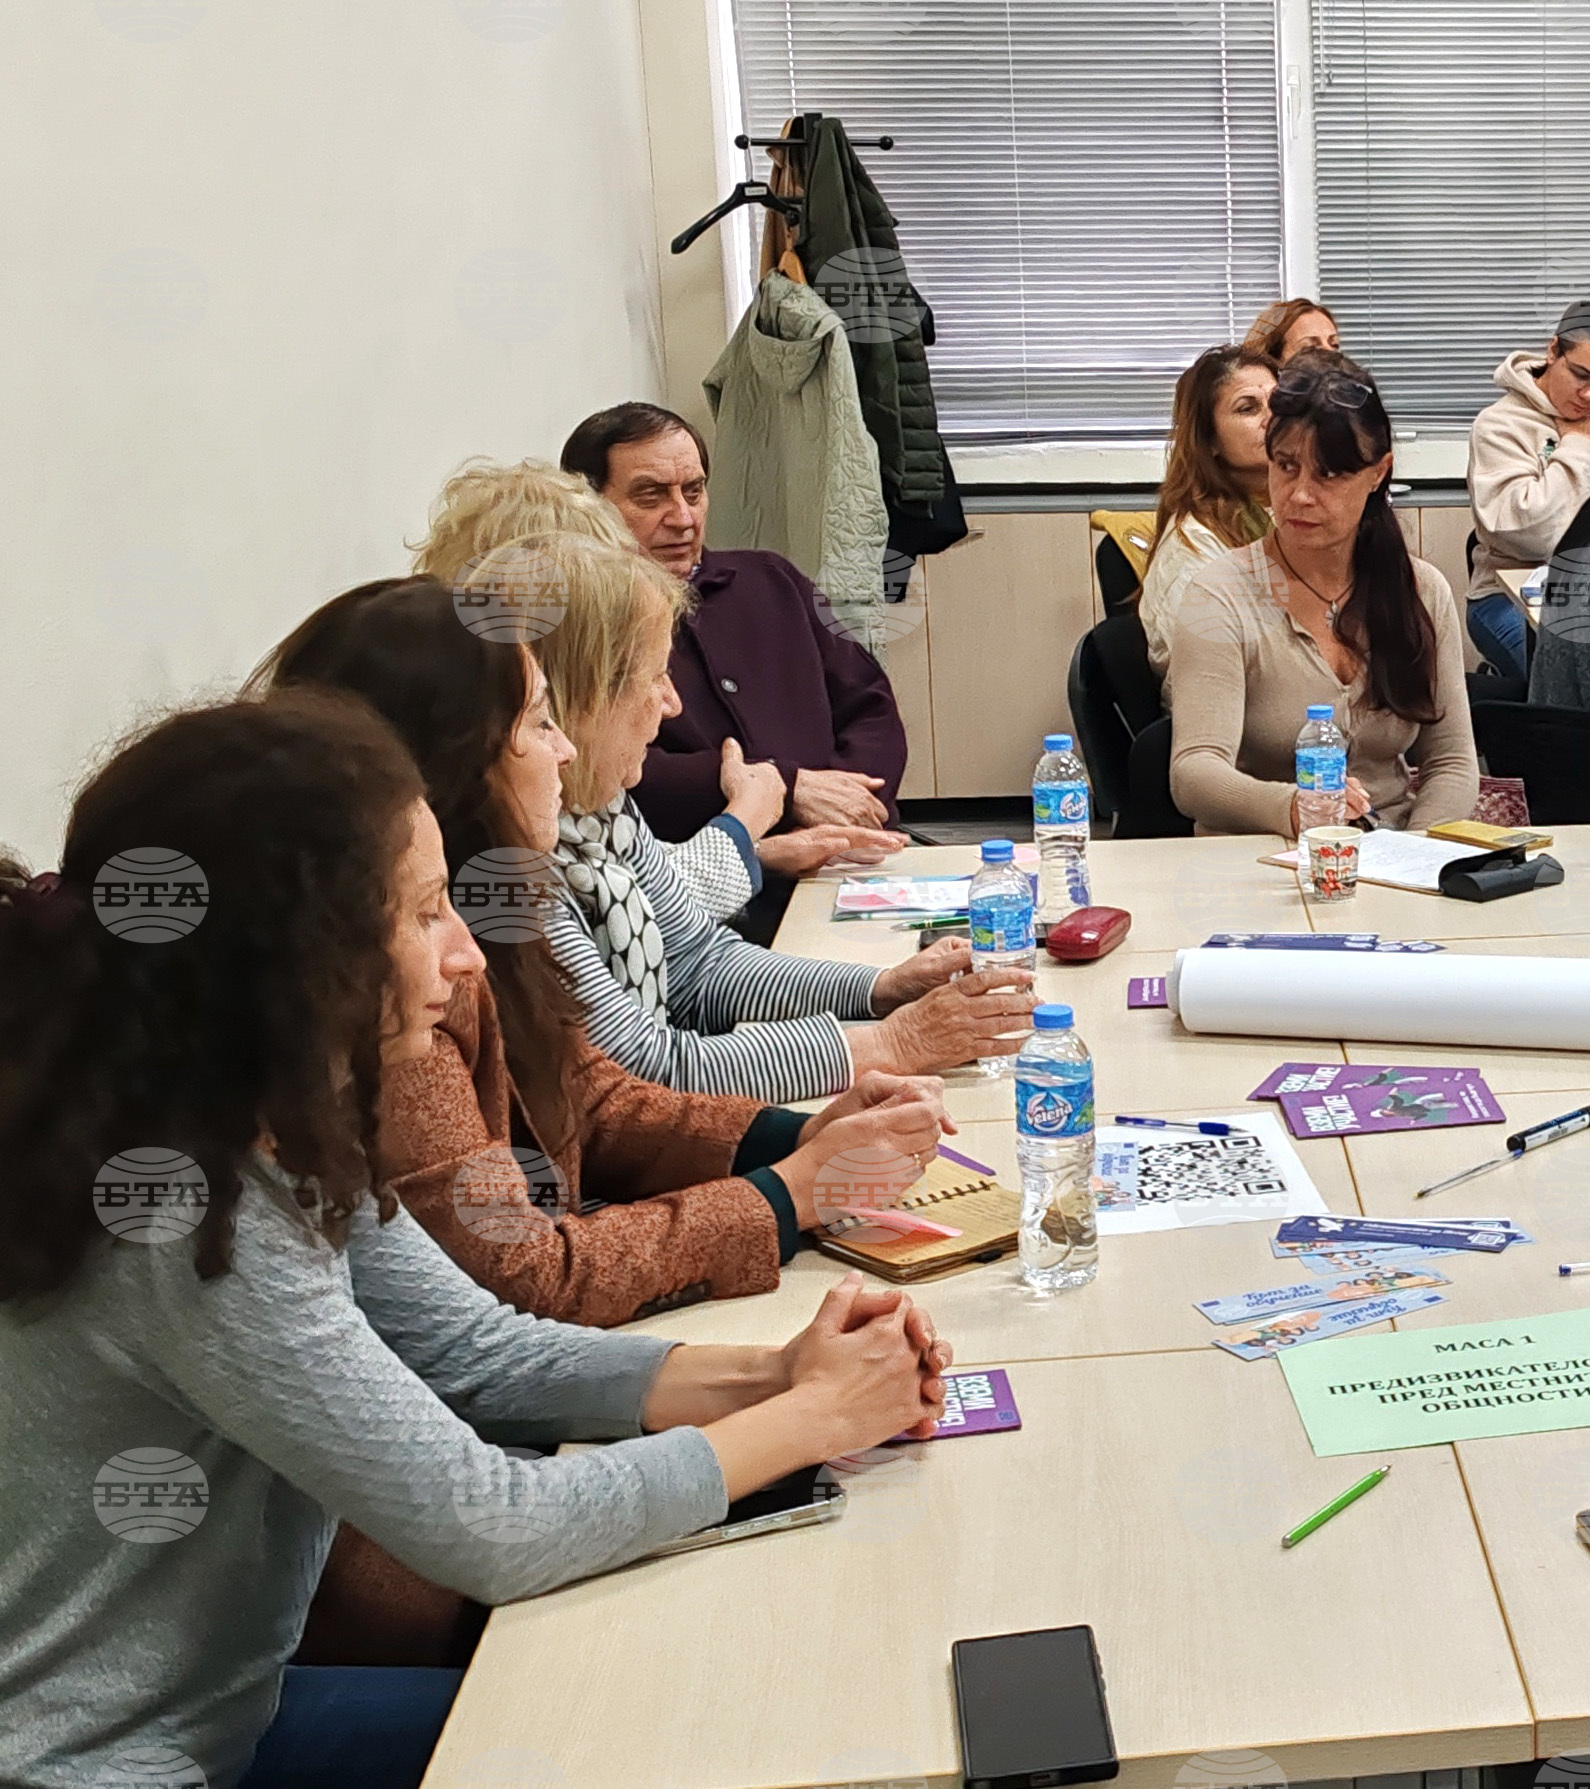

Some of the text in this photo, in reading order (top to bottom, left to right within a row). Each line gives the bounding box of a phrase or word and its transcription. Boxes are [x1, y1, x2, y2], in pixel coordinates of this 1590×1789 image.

[1433, 1334, 1538, 1355] МАСА 1
[955, 1374, 997, 1411] ВЗЕМИ
[1377, 1385, 1459, 1406] ПРЕД
